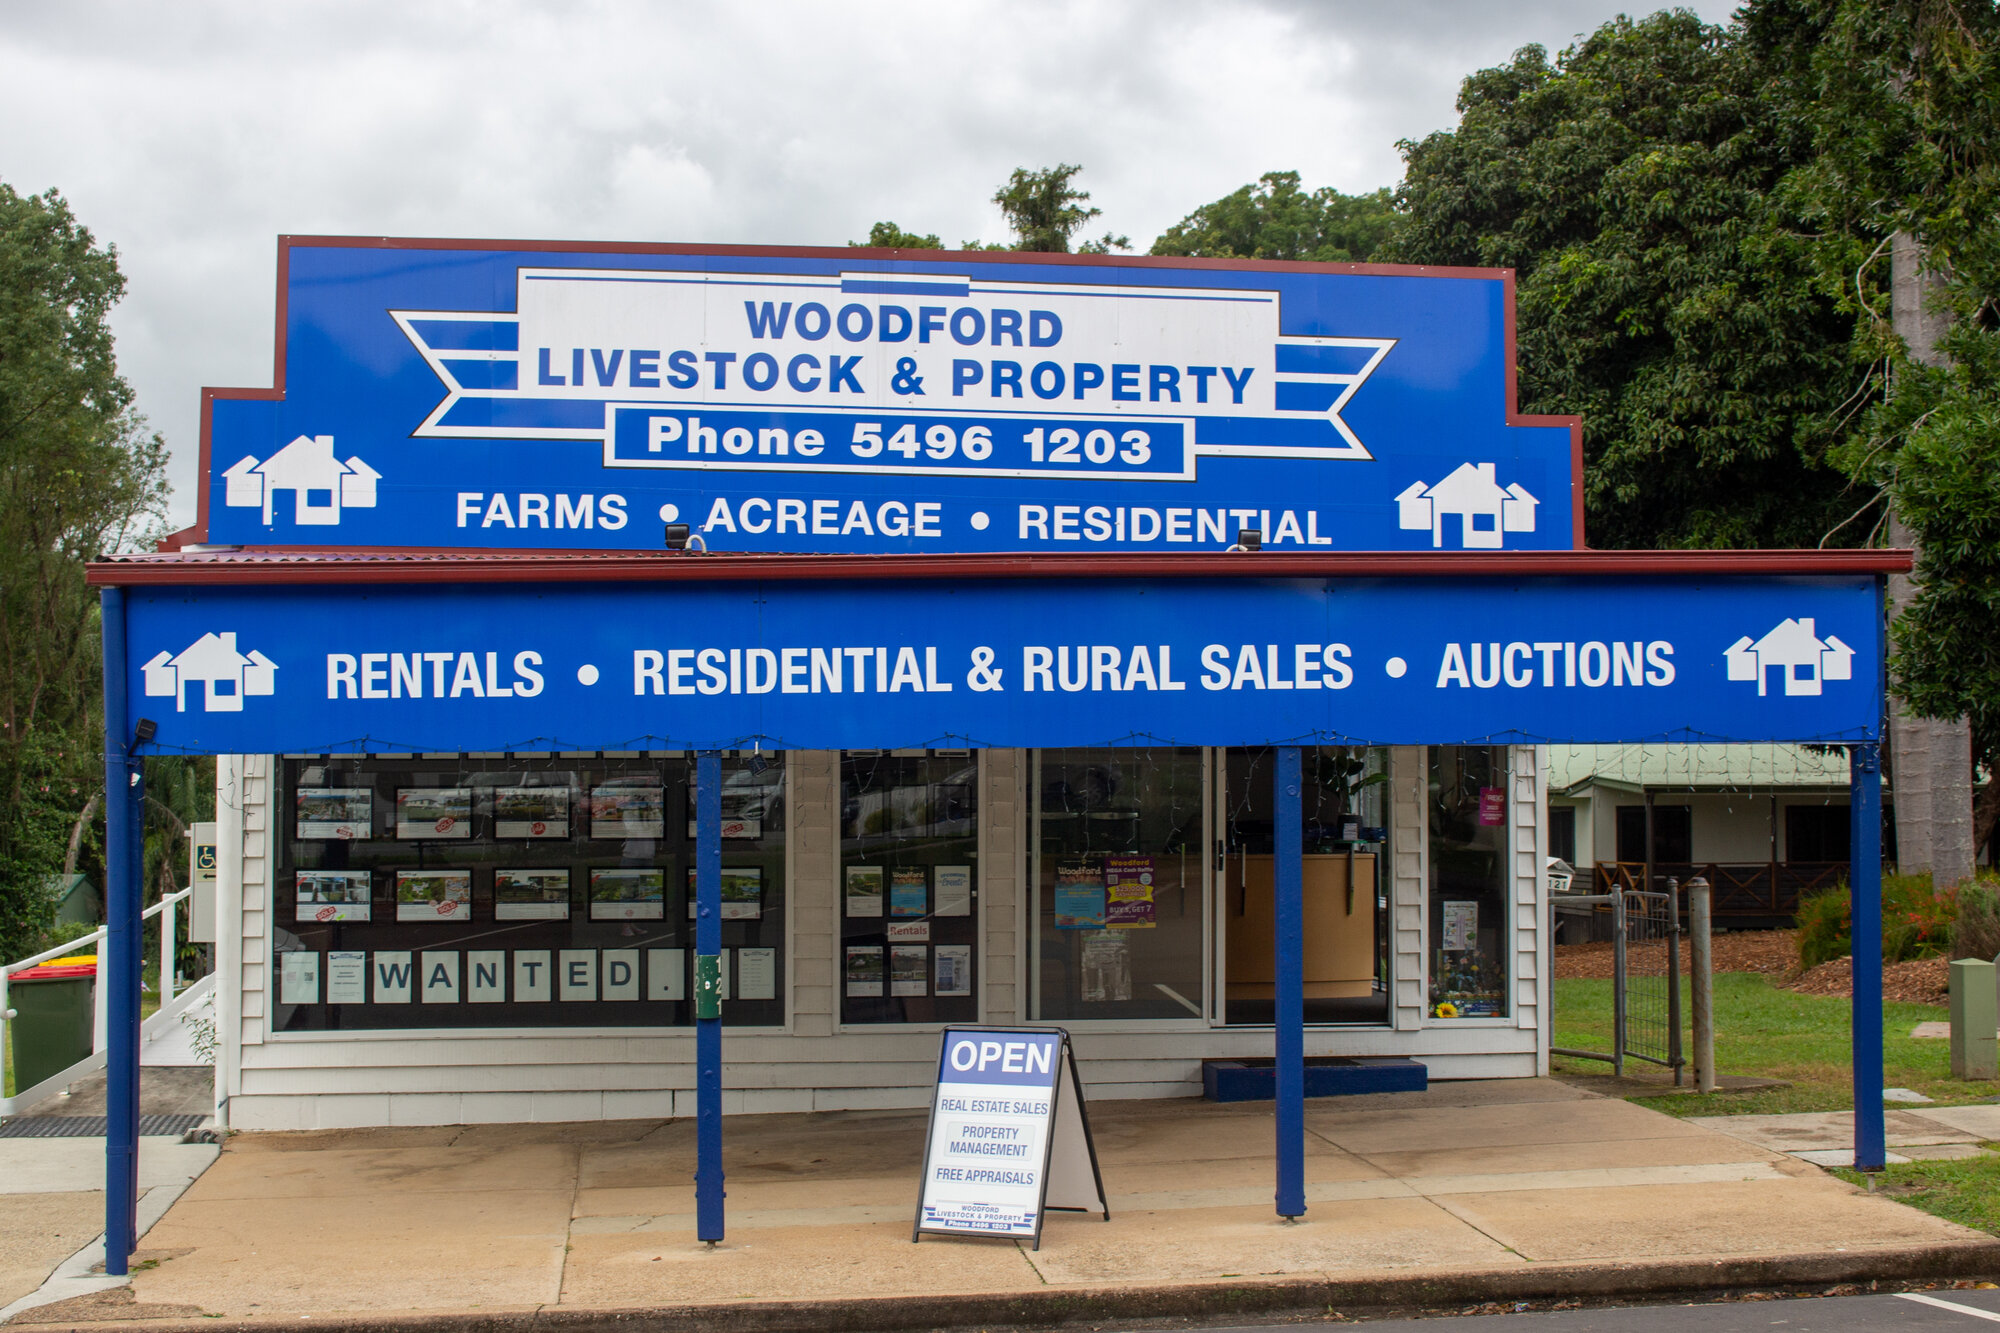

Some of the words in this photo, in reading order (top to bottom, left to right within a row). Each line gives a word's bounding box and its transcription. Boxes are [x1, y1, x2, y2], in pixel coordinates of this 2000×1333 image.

[744, 300, 1064, 348] WOODFORD
[538, 347, 864, 394] LIVESTOCK
[890, 356, 926, 396] &
[952, 359, 1256, 405] PROPERTY
[647, 416, 826, 458] Phone
[851, 423, 993, 463] 5496
[1022, 427, 1152, 466] 1203
[457, 492, 628, 530] FARMS
[705, 497, 942, 538] ACREAGE
[1019, 504, 1333, 546] RESIDENTIAL
[328, 650, 544, 699] RENTALS
[634, 646, 953, 696] RESIDENTIAL
[966, 646, 1004, 692] &
[1024, 645, 1186, 693] RURAL
[1201, 643, 1354, 692] SALES
[1437, 640, 1676, 689] AUCTIONS
[316, 907, 335, 920] SOLD
[889, 926, 928, 936] Rentals
[951, 1040, 1053, 1074] OPEN
[941, 1099, 968, 1112] REAL
[971, 1100, 1010, 1113] ESTATE
[1013, 1102, 1048, 1115] SALES
[962, 1126, 1019, 1140] PROPERTY
[949, 1141, 1028, 1156] MANAGEMENT
[936, 1168, 964, 1181] FREE
[965, 1169, 1034, 1185] APPRAISALS
[937, 1211, 975, 1219] LIVESTOCK
[984, 1213, 1021, 1221] PROPERTY
[961, 1205, 1000, 1213] WOODFORD
